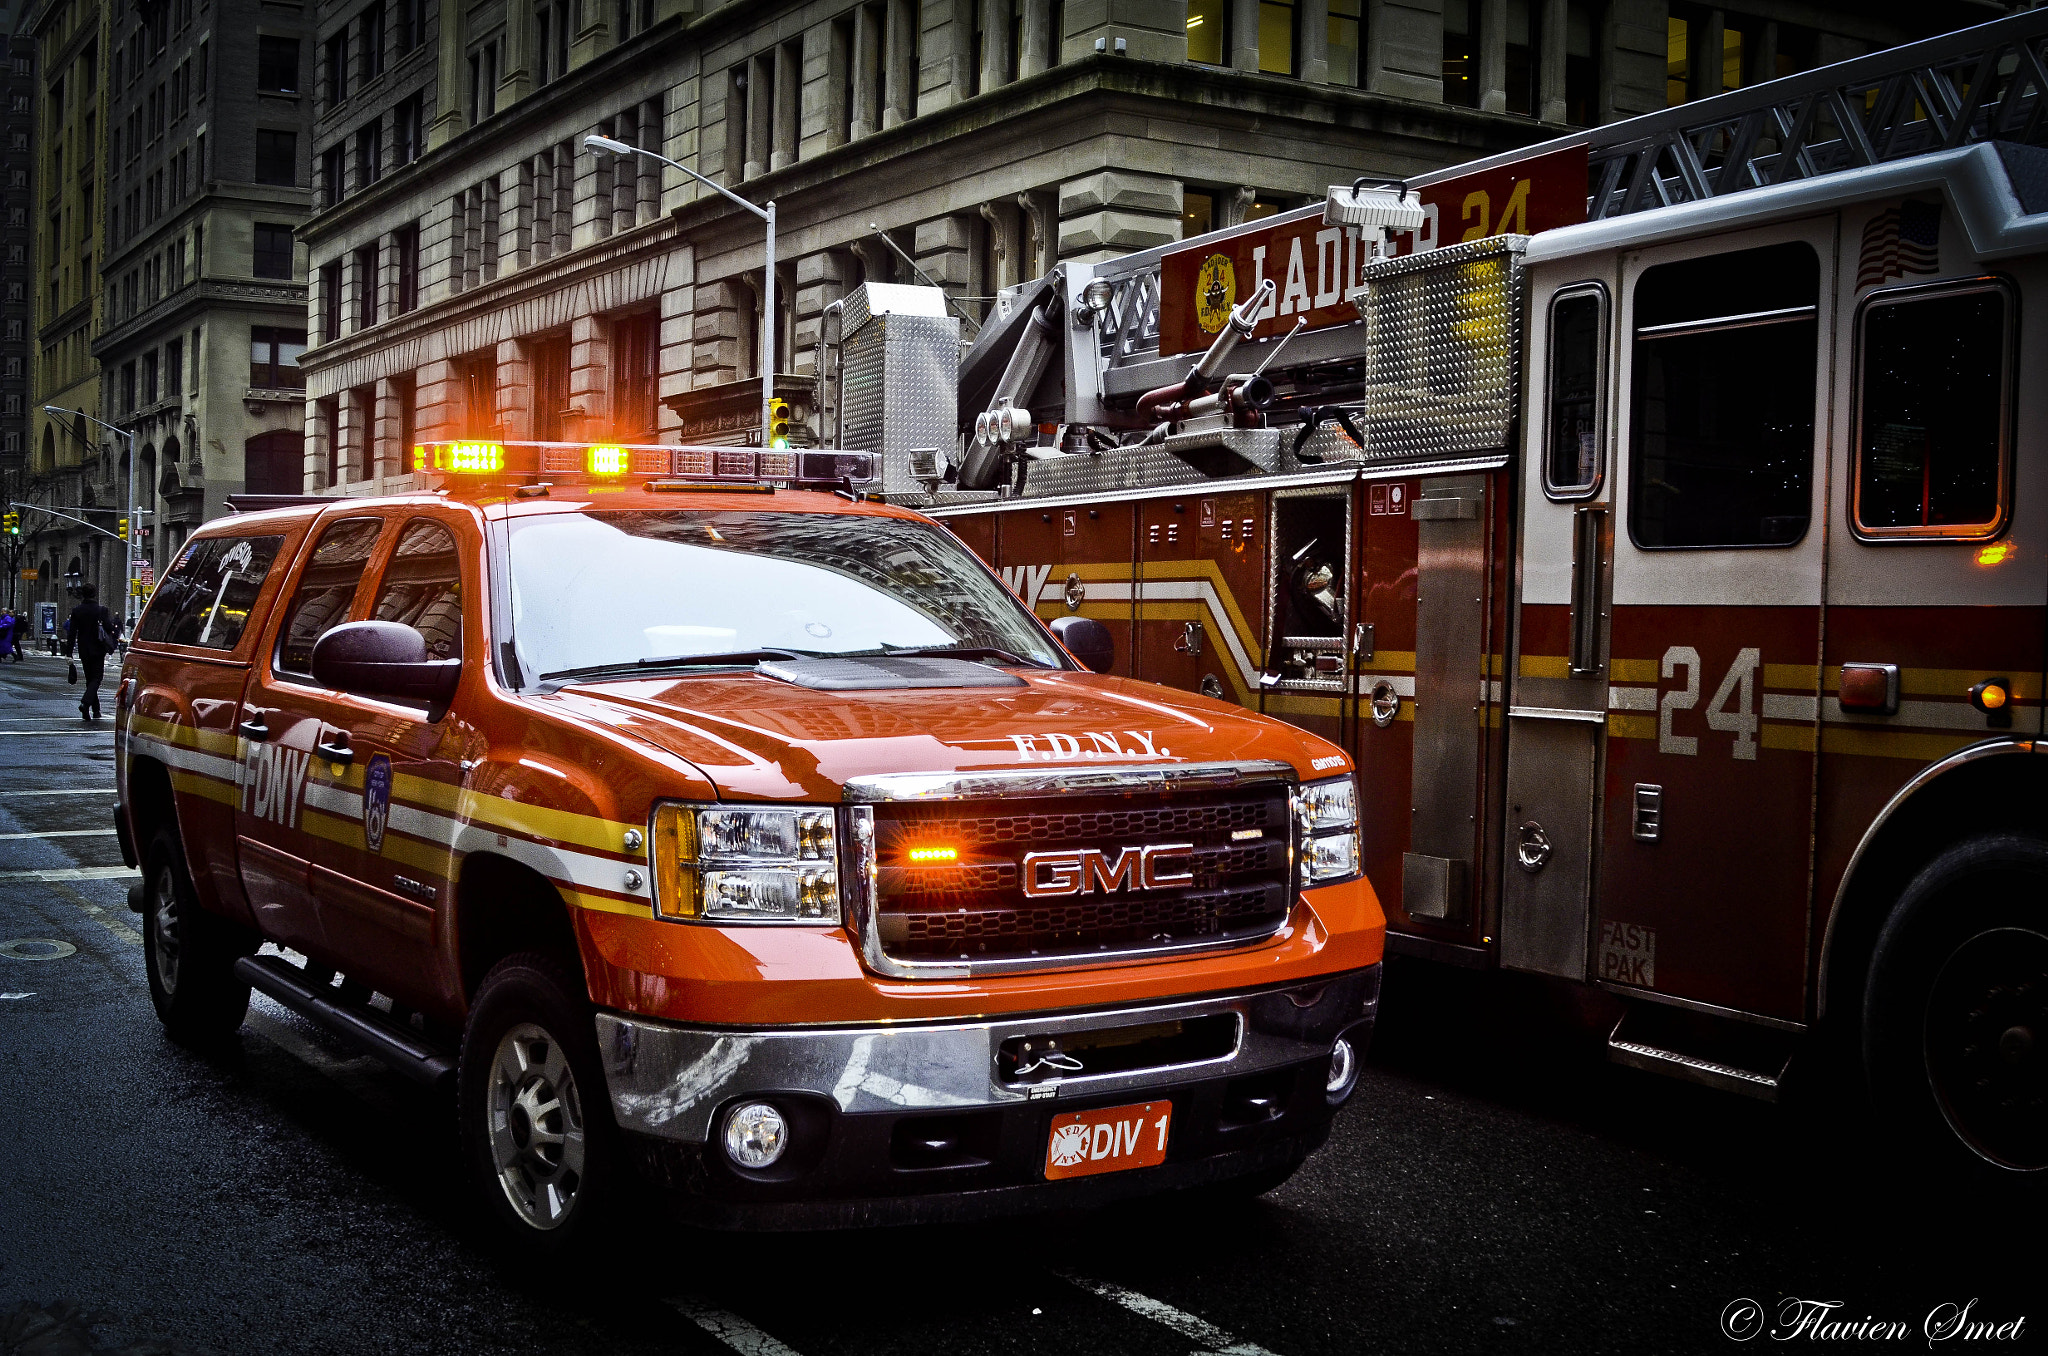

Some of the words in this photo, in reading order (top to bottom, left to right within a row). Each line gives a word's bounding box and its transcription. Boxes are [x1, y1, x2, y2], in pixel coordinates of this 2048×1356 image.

[1462, 179, 1530, 241] 24
[1659, 646, 1760, 760] 24
[1006, 730, 1171, 762] F.D.N.Y.
[241, 741, 311, 829] FDNY
[1023, 843, 1194, 898] GMC
[1600, 920, 1656, 952] FAST
[1605, 952, 1647, 986] PAK
[1091, 1118, 1144, 1160] DIV
[1155, 1114, 1168, 1151] 1
